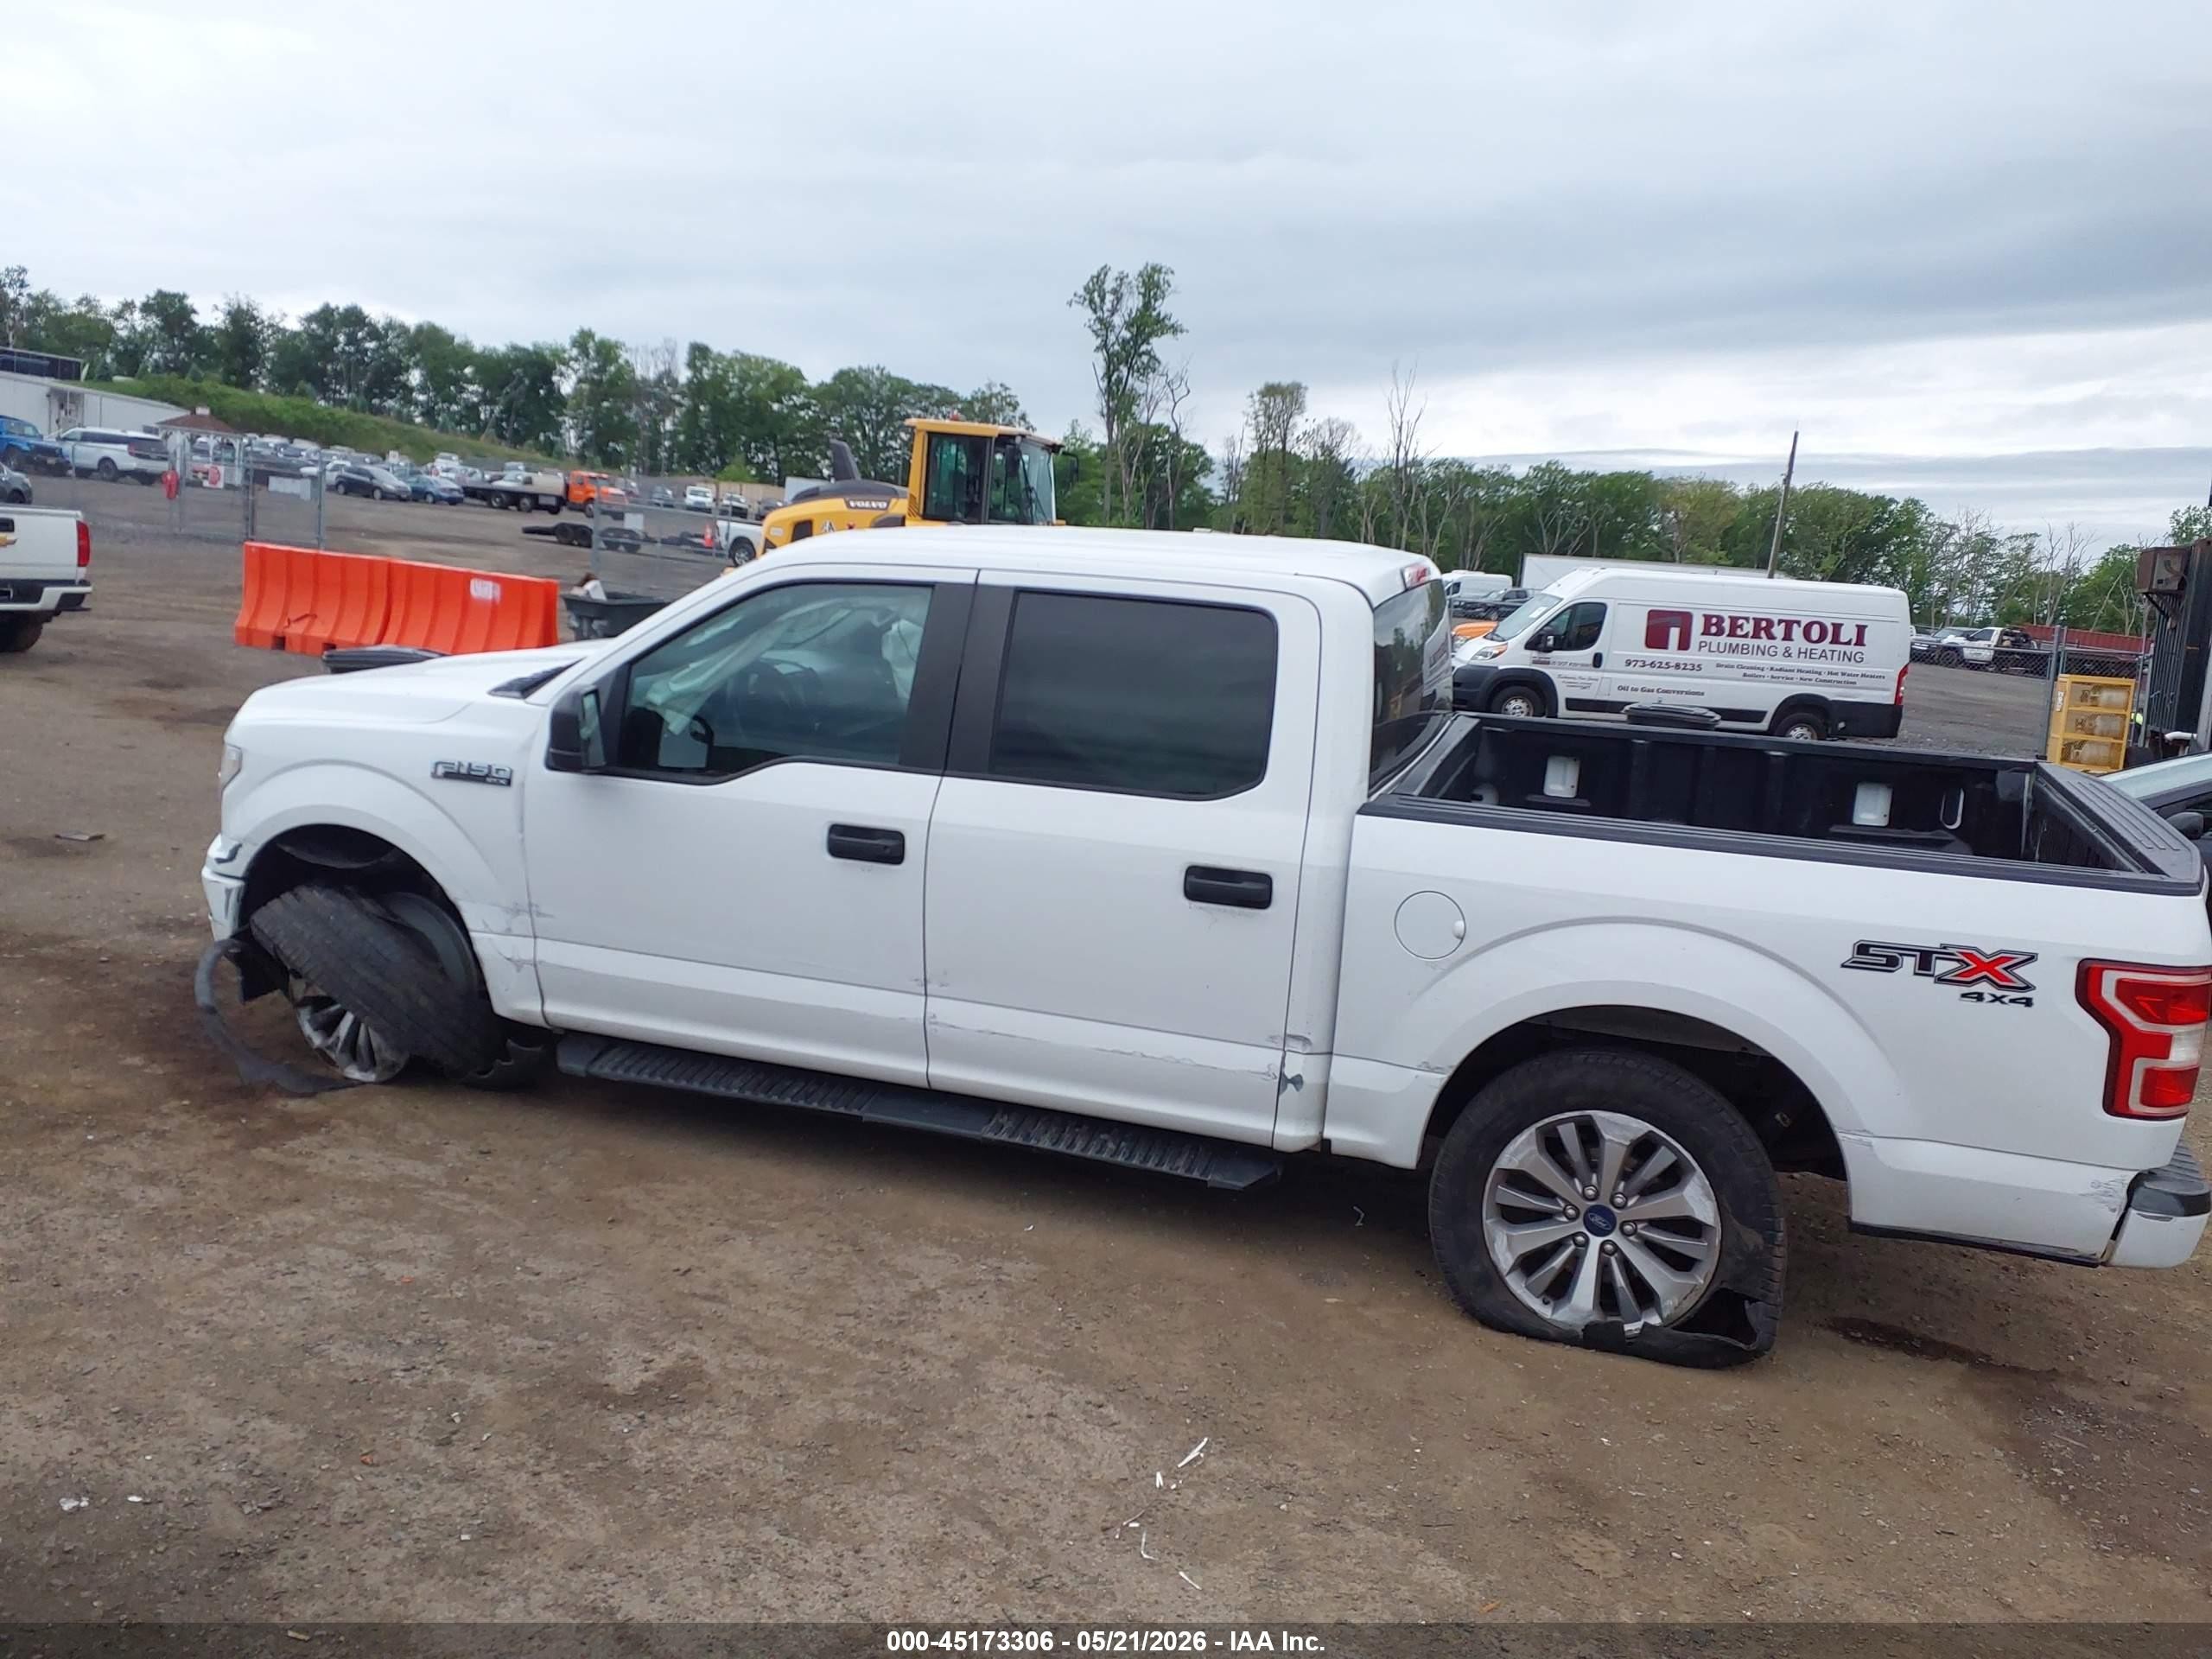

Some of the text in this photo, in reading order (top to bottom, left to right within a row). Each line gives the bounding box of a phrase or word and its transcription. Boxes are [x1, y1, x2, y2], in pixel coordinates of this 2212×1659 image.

[849, 499, 887, 509] VOLVO
[1700, 613, 1869, 647] BERTOLI
[1698, 640, 1866, 664] PLUMBING & HEATING
[1624, 658, 1703, 671] 973-625-8235
[1815, 677, 1857, 685] Construction
[1860, 671, 1885, 680] Heaters
[1656, 687, 1705, 696] Conversions
[431, 760, 513, 780] F150
[1840, 939, 2039, 993] STX
